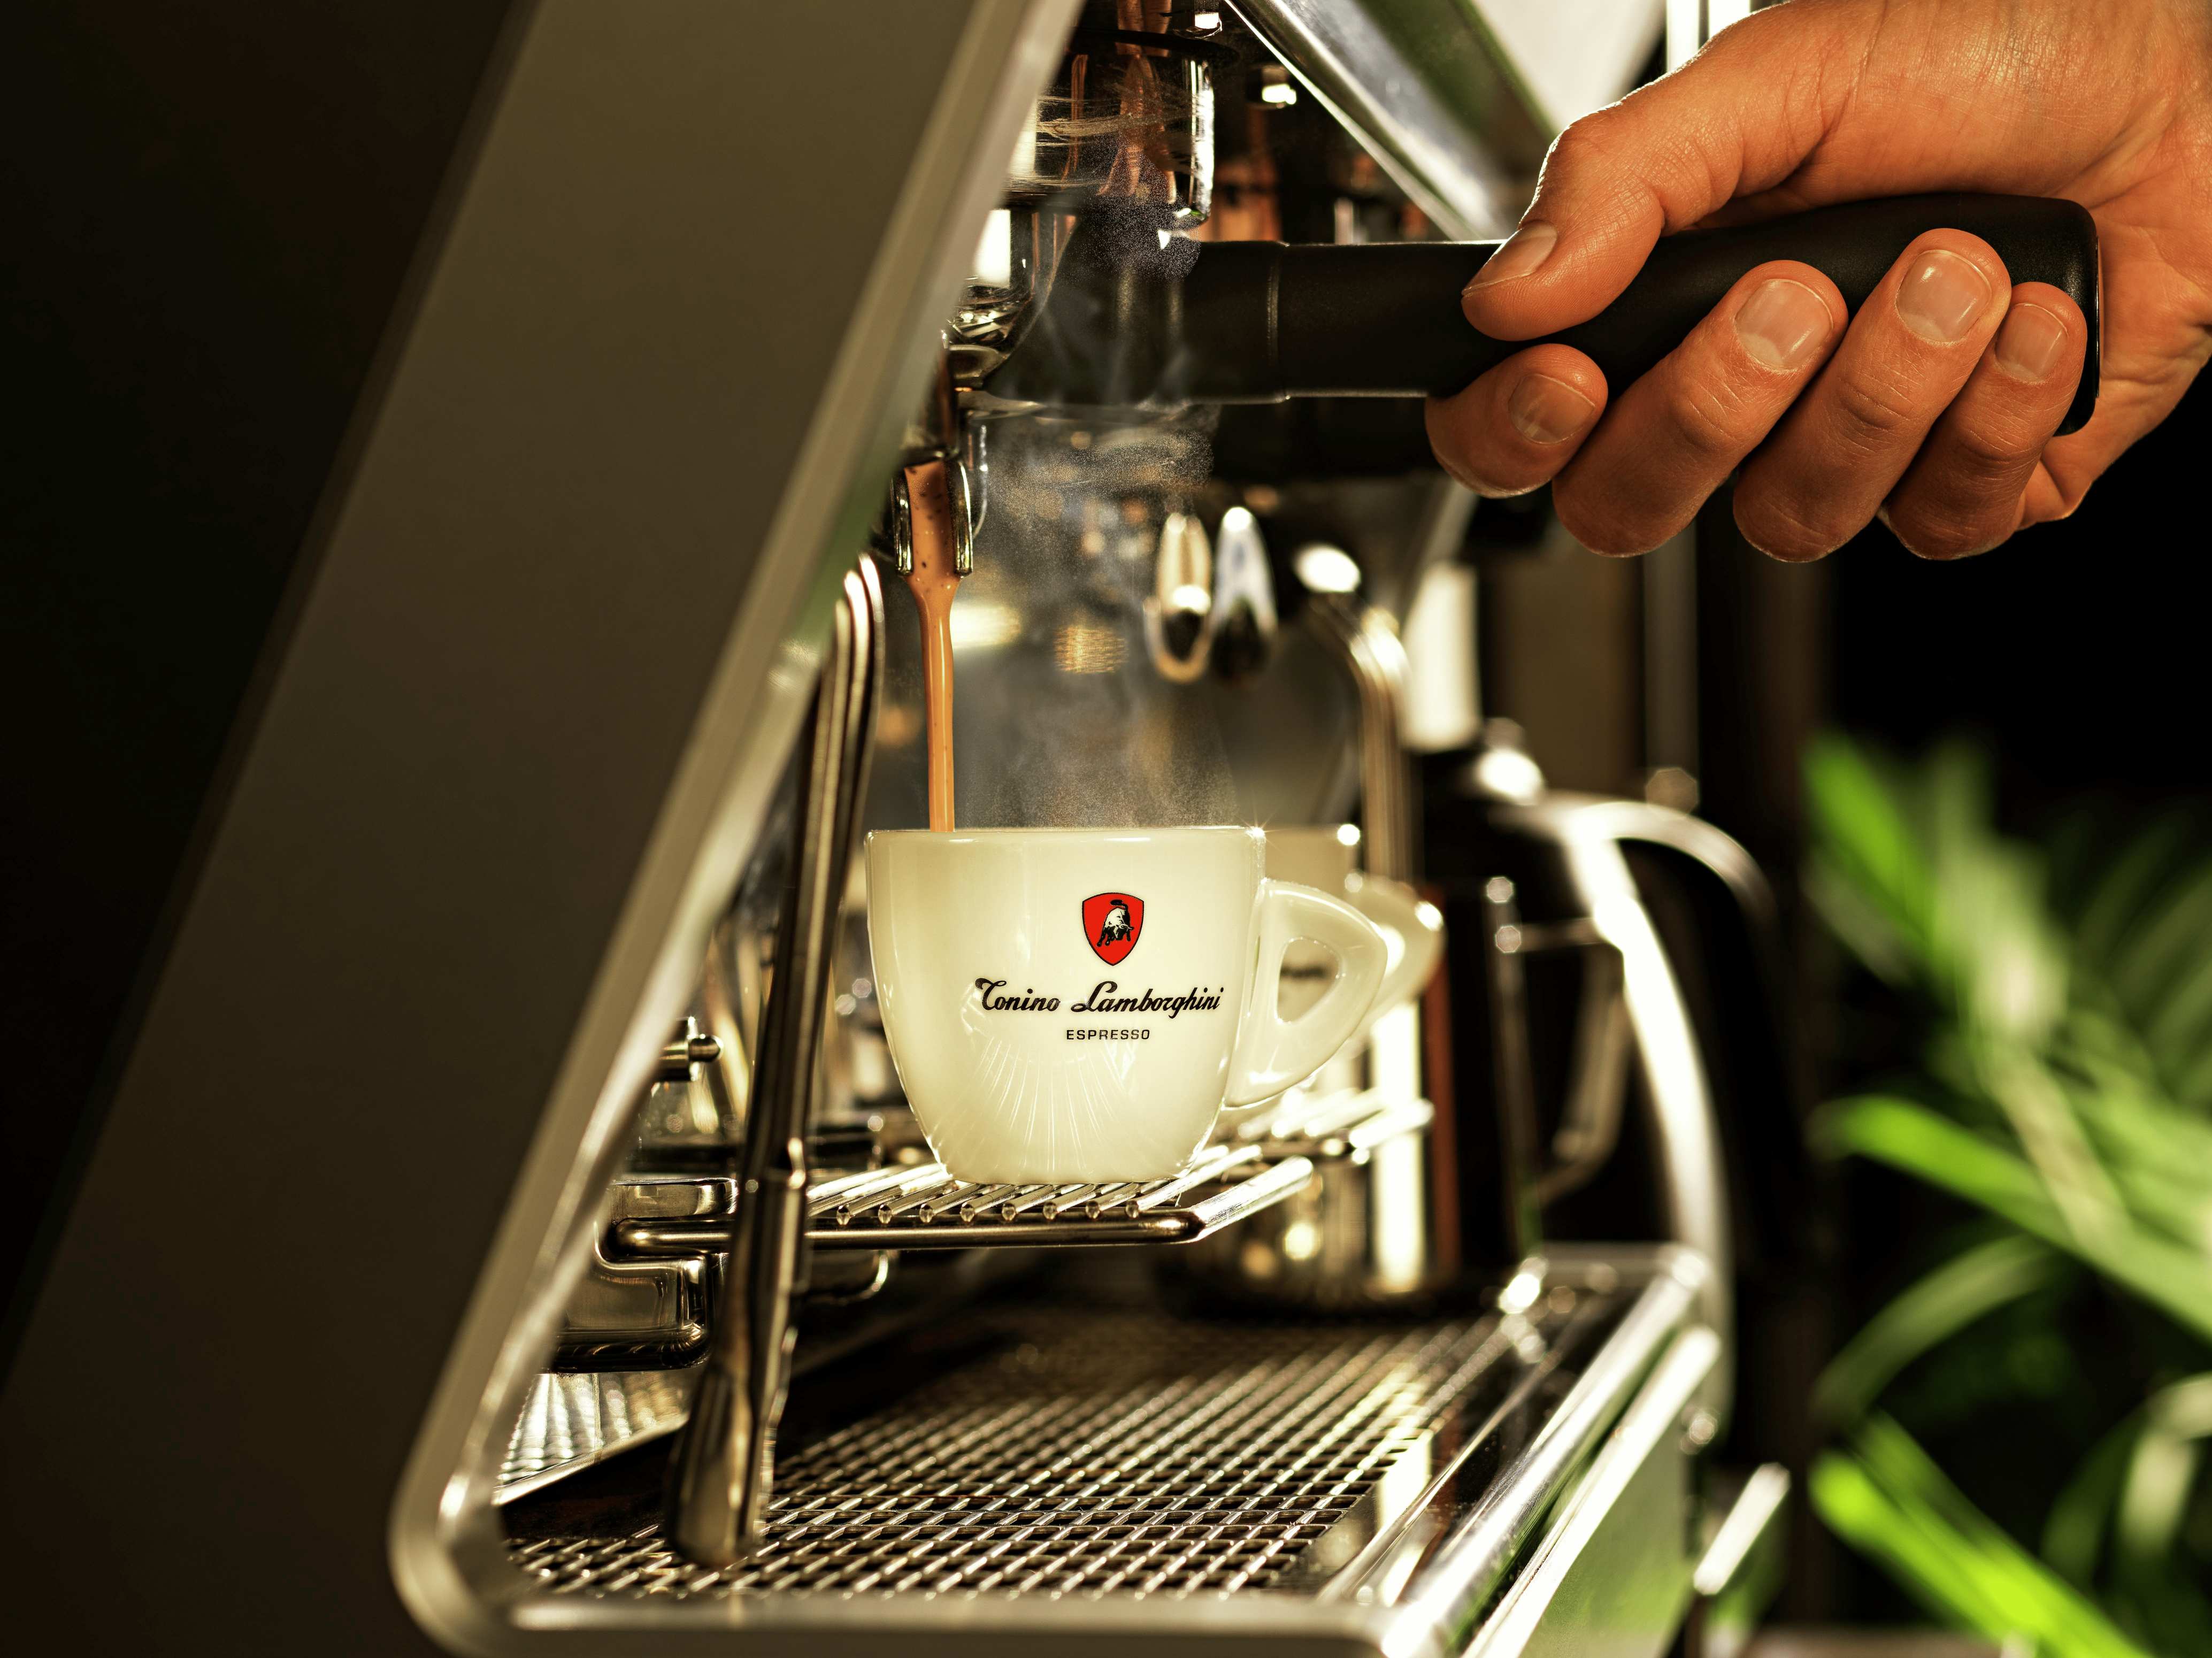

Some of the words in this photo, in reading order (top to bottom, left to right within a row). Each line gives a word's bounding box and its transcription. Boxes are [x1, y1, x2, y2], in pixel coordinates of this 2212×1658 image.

[975, 978, 1061, 1012] Tonino
[1070, 980, 1224, 1019] Lamborghini
[1066, 1029, 1150, 1040] ESPRESSO
